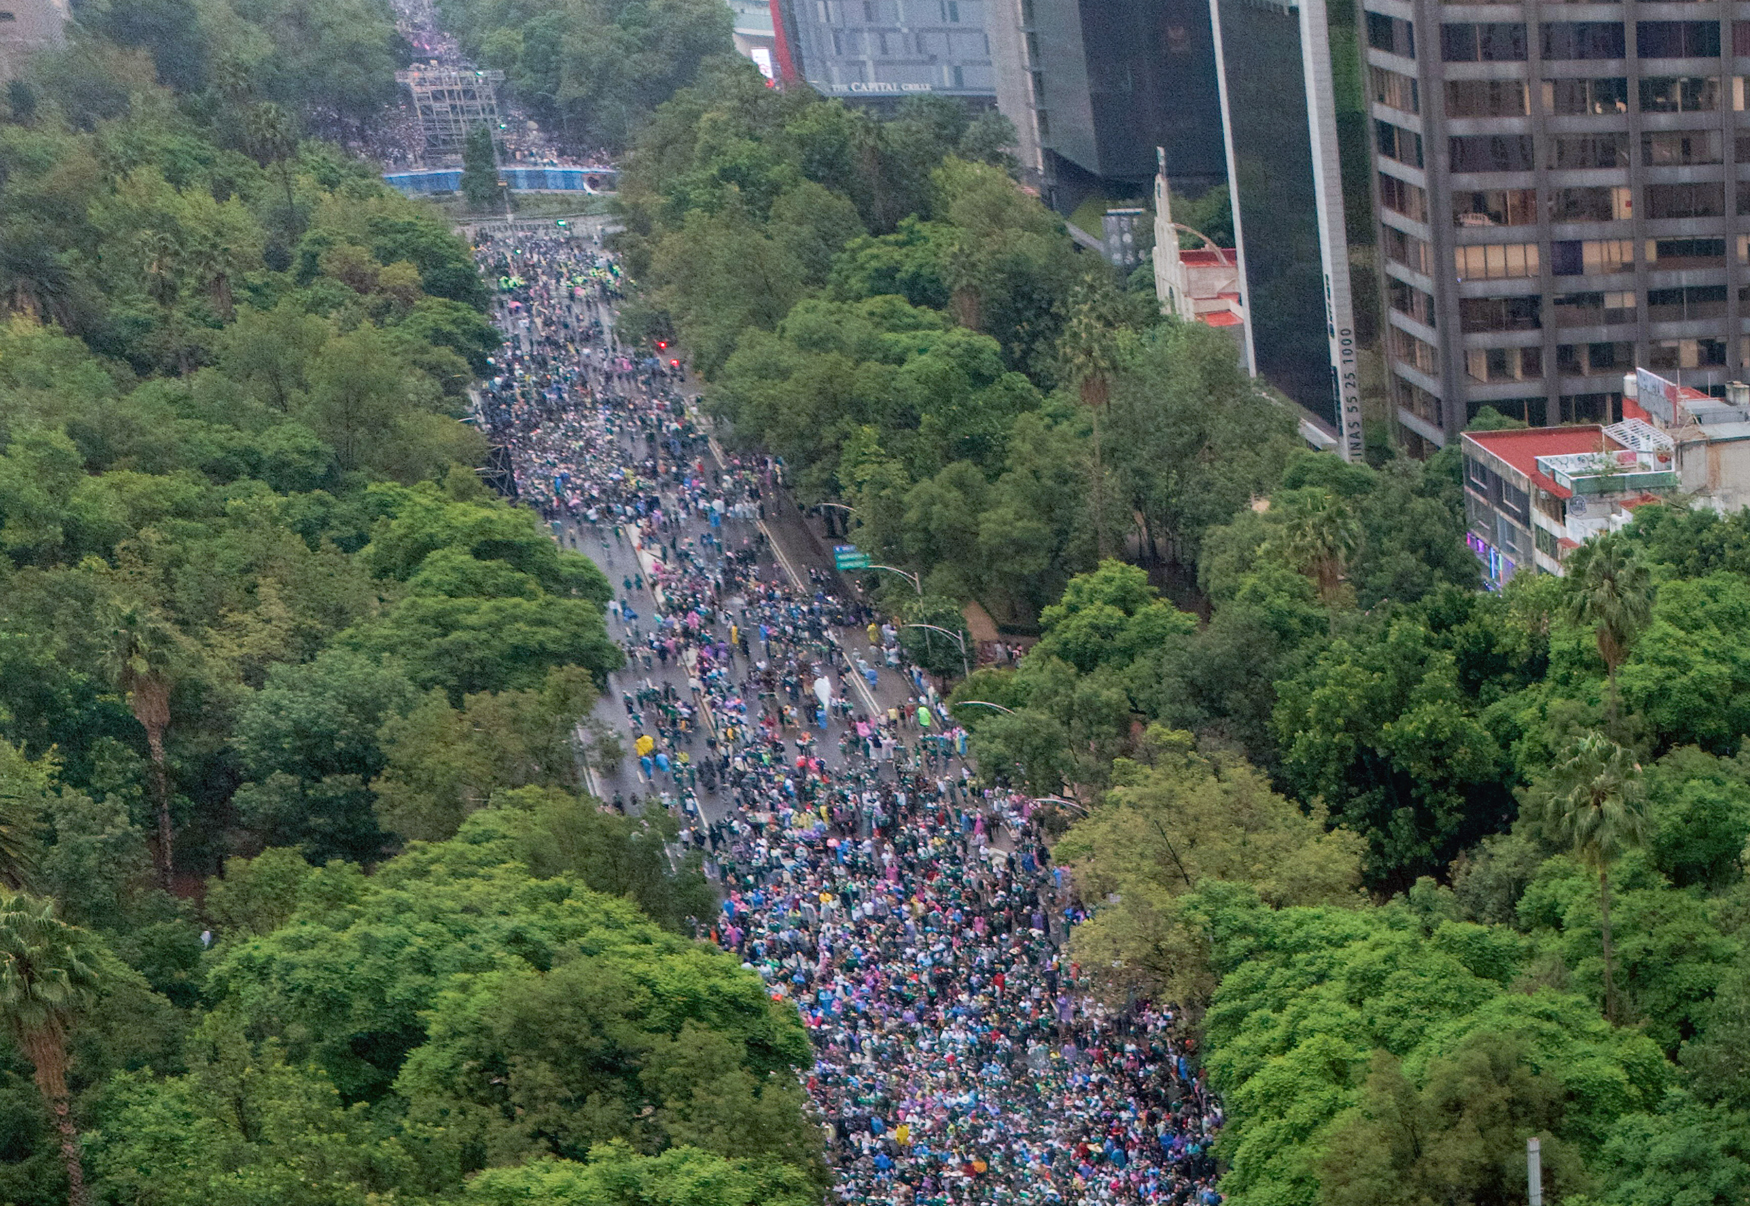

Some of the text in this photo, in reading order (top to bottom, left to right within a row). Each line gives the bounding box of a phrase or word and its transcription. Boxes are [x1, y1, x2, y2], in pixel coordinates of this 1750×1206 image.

[850, 82, 899, 92] CAPITAL
[901, 83, 932, 91] GRILLE
[1340, 328, 1354, 365] 1000
[1345, 372, 1357, 389] 25
[1346, 396, 1359, 413] 55
